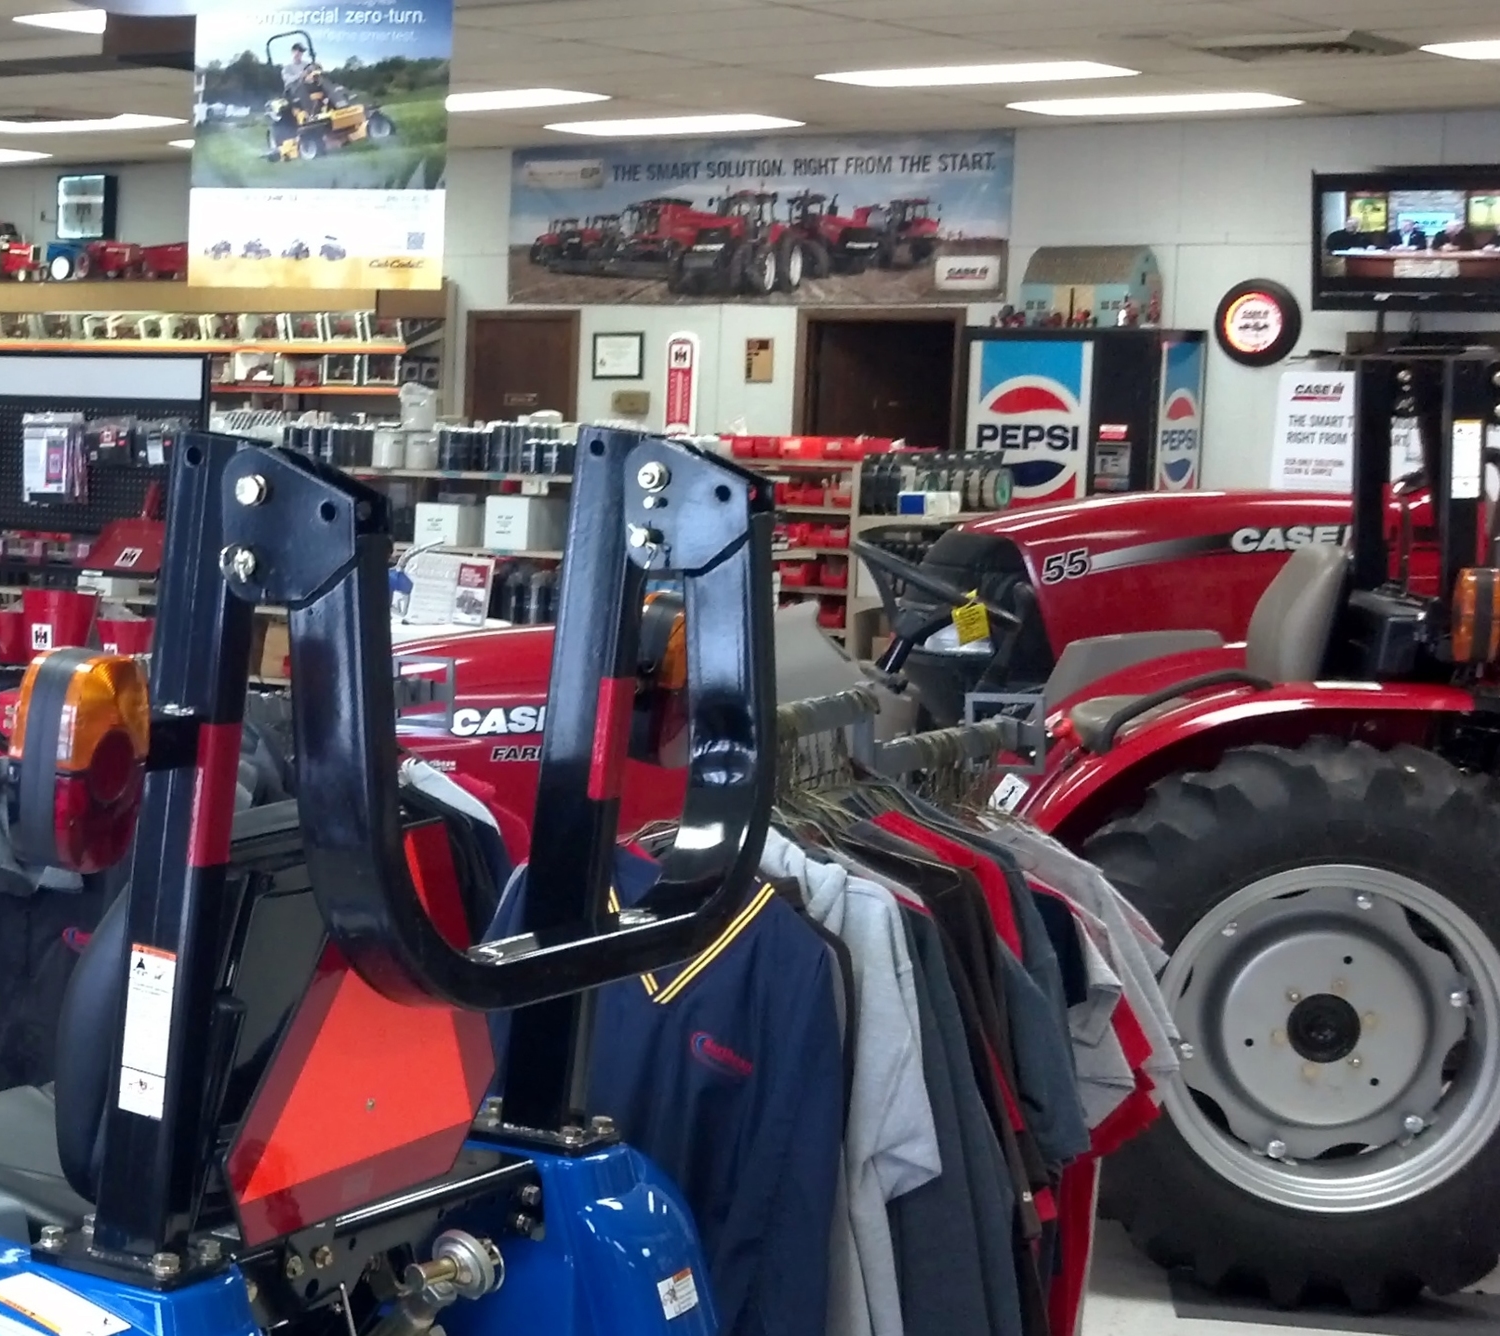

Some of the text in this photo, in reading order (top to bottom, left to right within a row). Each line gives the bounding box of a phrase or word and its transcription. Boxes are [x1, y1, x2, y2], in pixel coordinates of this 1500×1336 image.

[345, 8, 426, 24] zero-turn.
[612, 152, 996, 181] THE SMART SOLUTION. RIGHT FROM THE START.
[1295, 384, 1330, 395] CASE
[1288, 415, 1307, 427] THE
[1310, 415, 1344, 428] SMART
[977, 424, 1078, 450] PEPSI
[1161, 429, 1197, 450] PEPSI
[1287, 432, 1316, 445] RIGHT
[1319, 432, 1347, 445] FROM
[1230, 525, 1338, 553] CASE
[1041, 547, 1089, 585] 55
